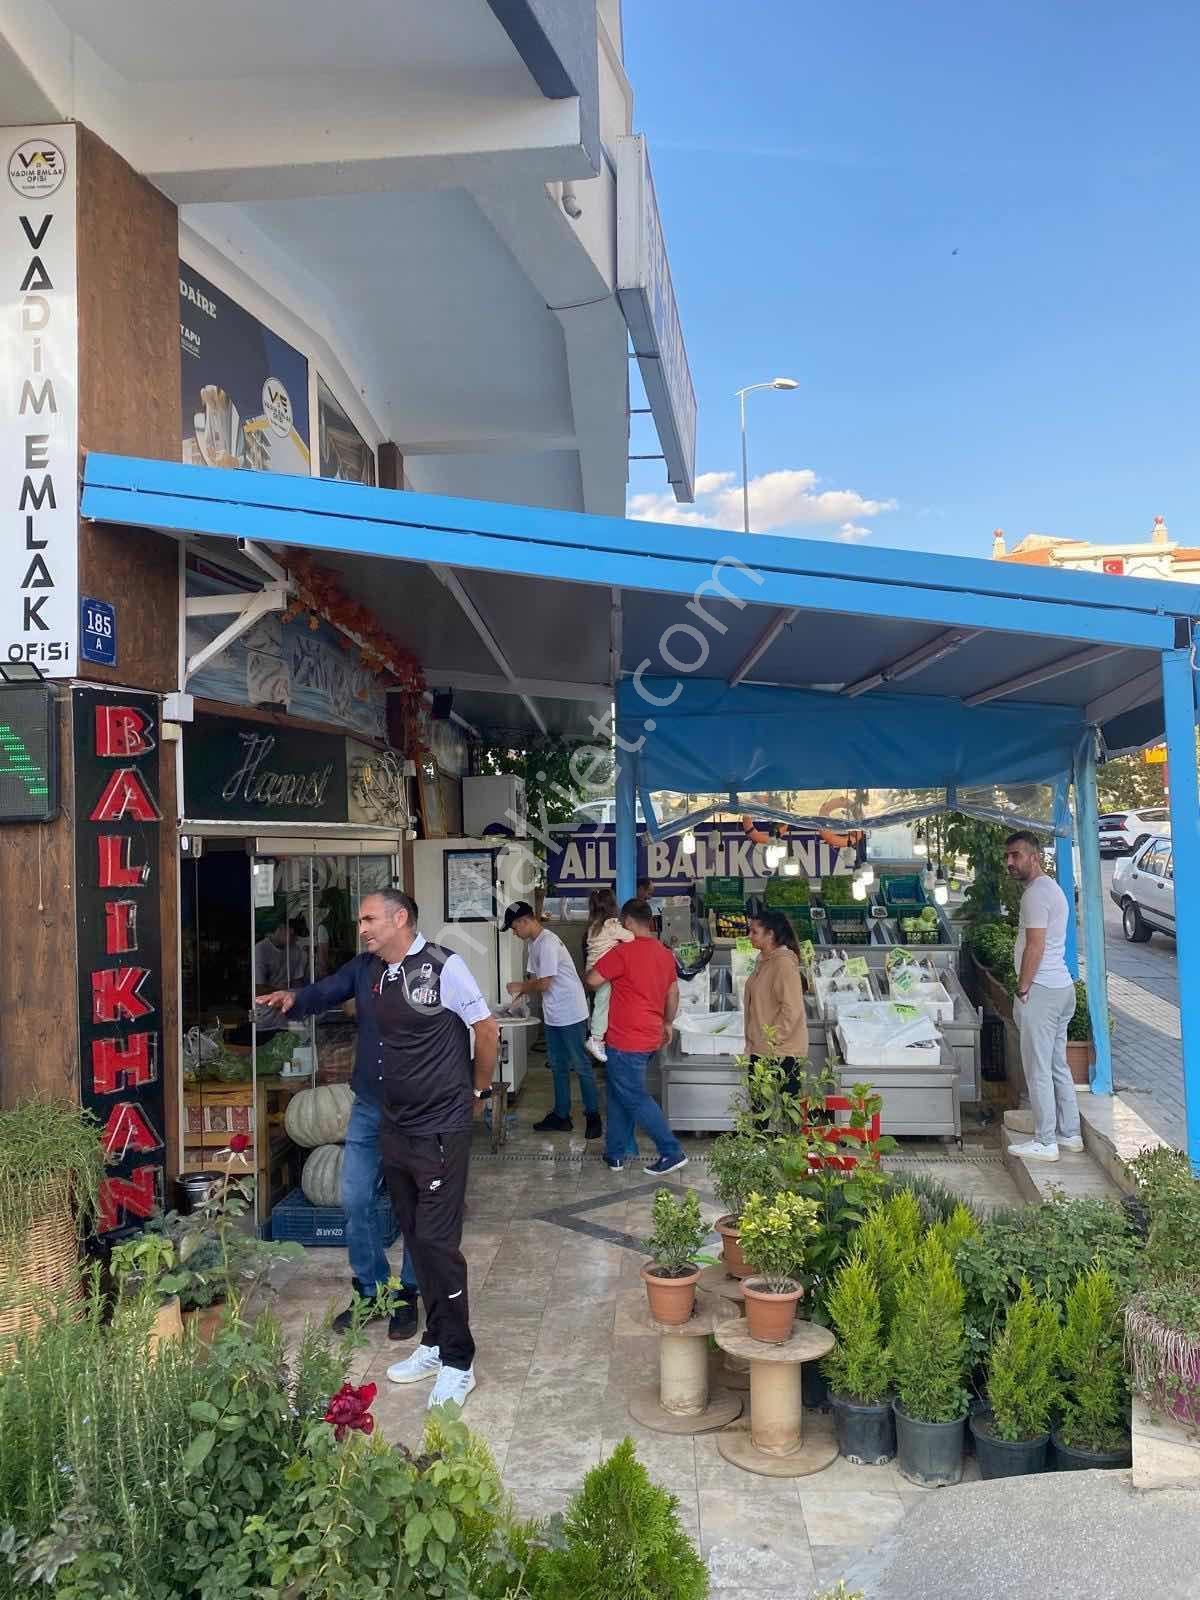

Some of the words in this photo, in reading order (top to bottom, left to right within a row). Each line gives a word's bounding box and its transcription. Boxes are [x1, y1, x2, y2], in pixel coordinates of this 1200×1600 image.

[180, 324, 200, 346] TAPU
[18, 434, 57, 632] EMLAK
[87, 610, 112, 636] 185
[95, 638, 103, 650] A
[559, 841, 617, 879] AİL
